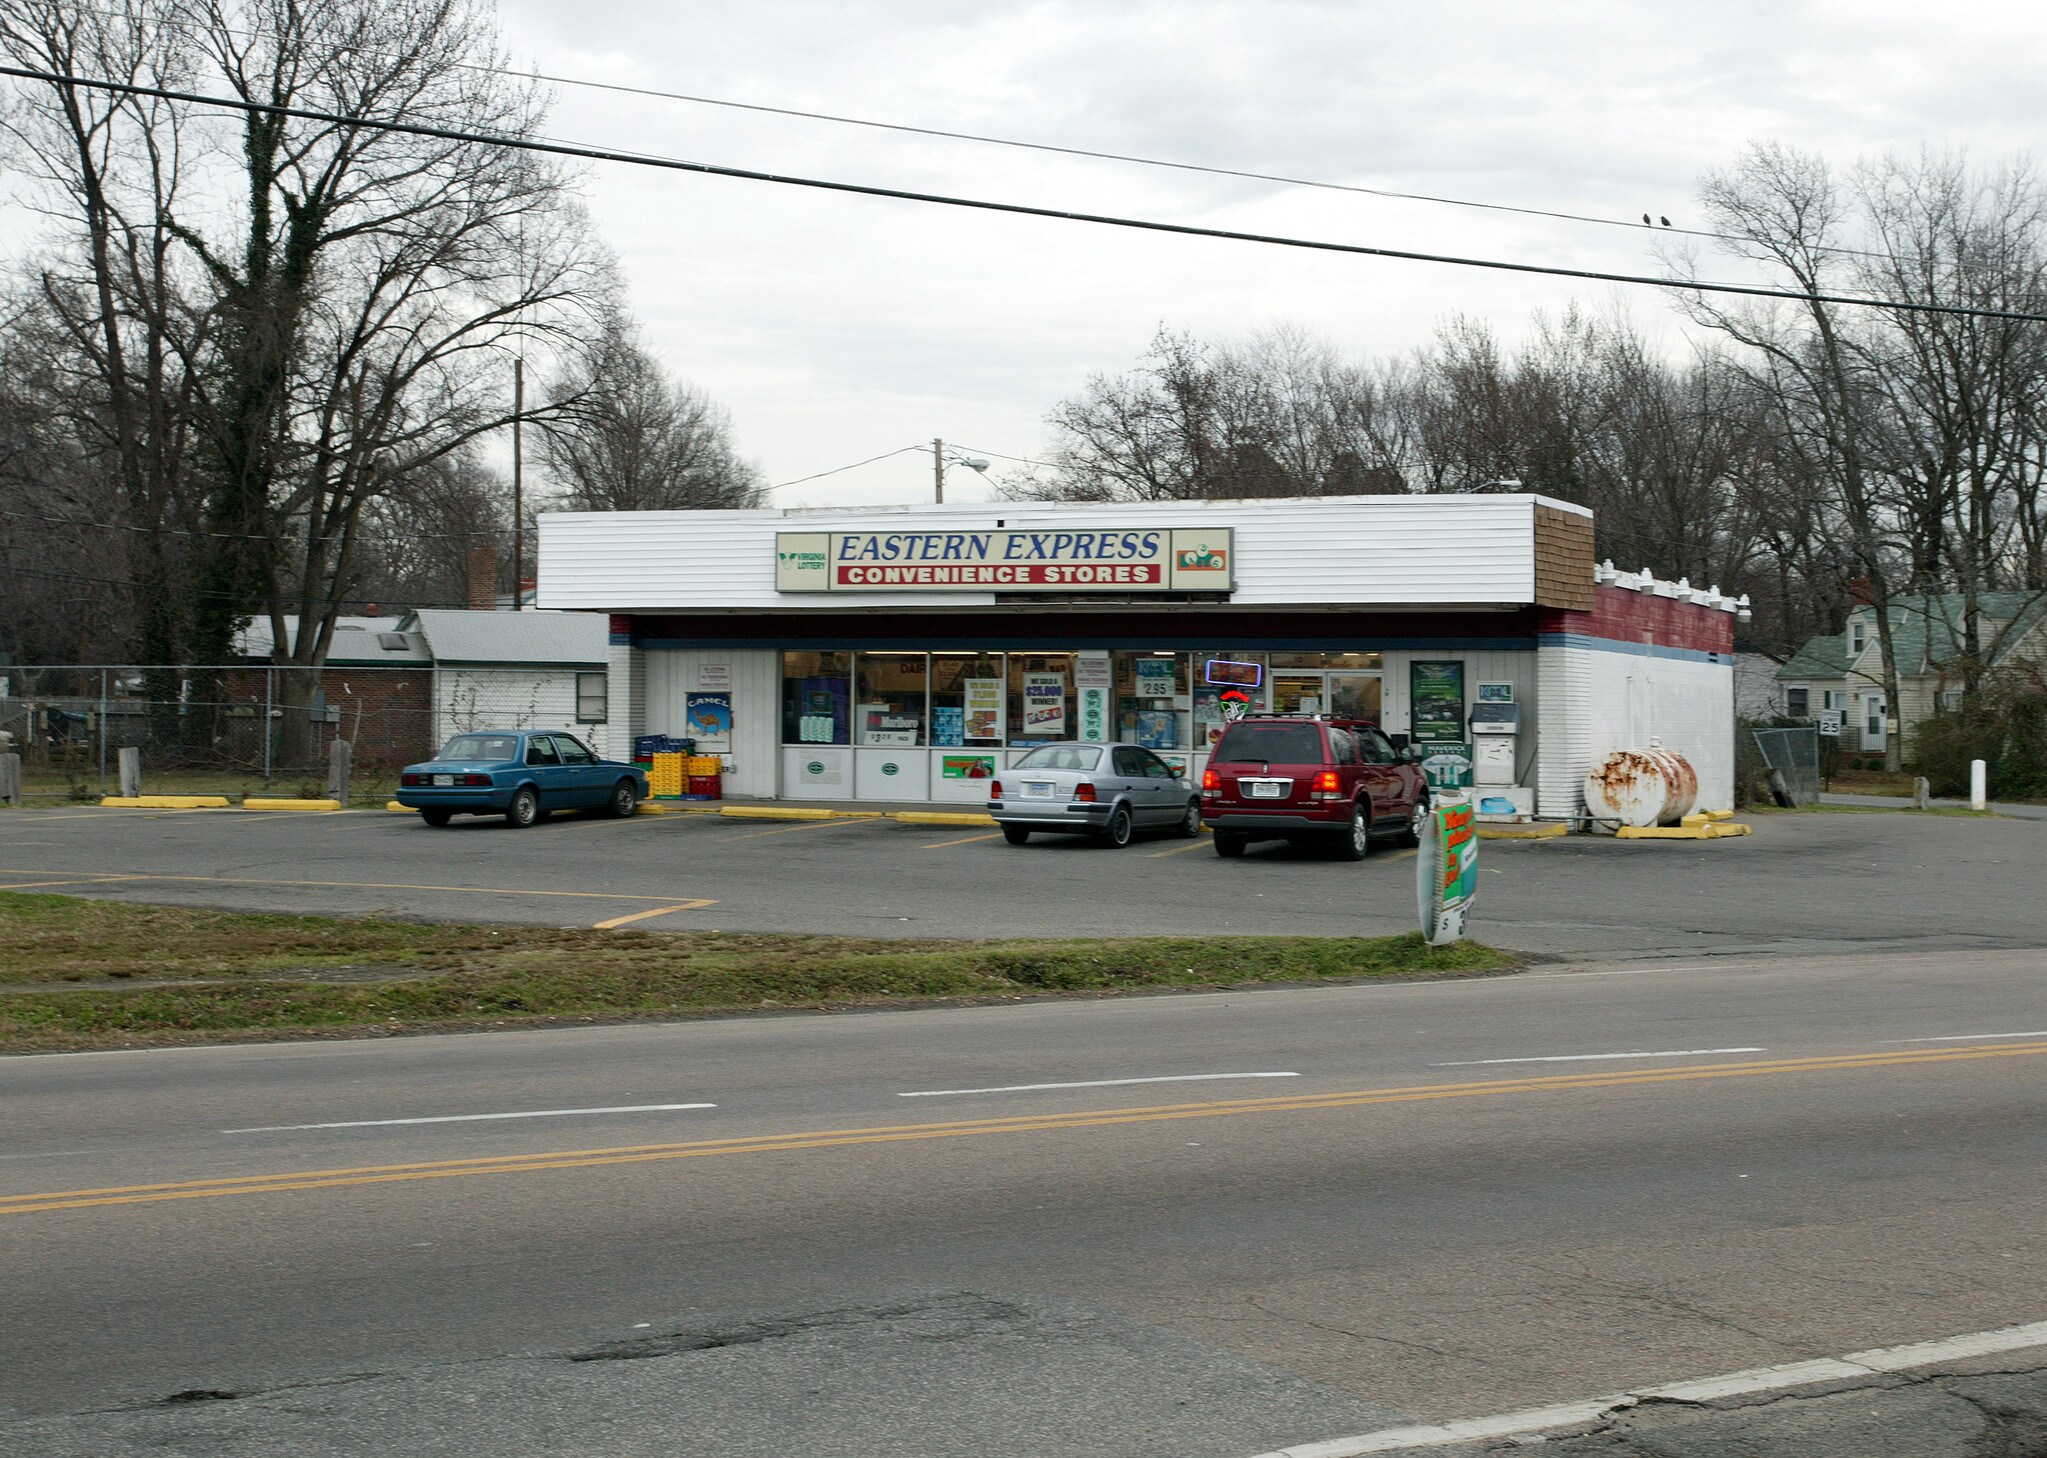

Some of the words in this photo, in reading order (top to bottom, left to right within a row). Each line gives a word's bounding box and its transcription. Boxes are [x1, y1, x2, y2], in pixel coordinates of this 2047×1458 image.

[838, 534, 993, 561] EASTERN
[1003, 532, 1161, 560] EXPRESS
[797, 553, 826, 561] VIRGINIA
[797, 562, 825, 570] LOTTERY
[847, 566, 1031, 583] CONVENIENCE
[1044, 566, 1150, 582] STORES
[900, 663, 927, 674] DAIR
[1138, 661, 1173, 673] KOOL
[1480, 686, 1511, 697] KOOL
[688, 697, 729, 708] CAMEL
[880, 716, 919, 729] Marlboro
[1822, 722, 1840, 733] 25
